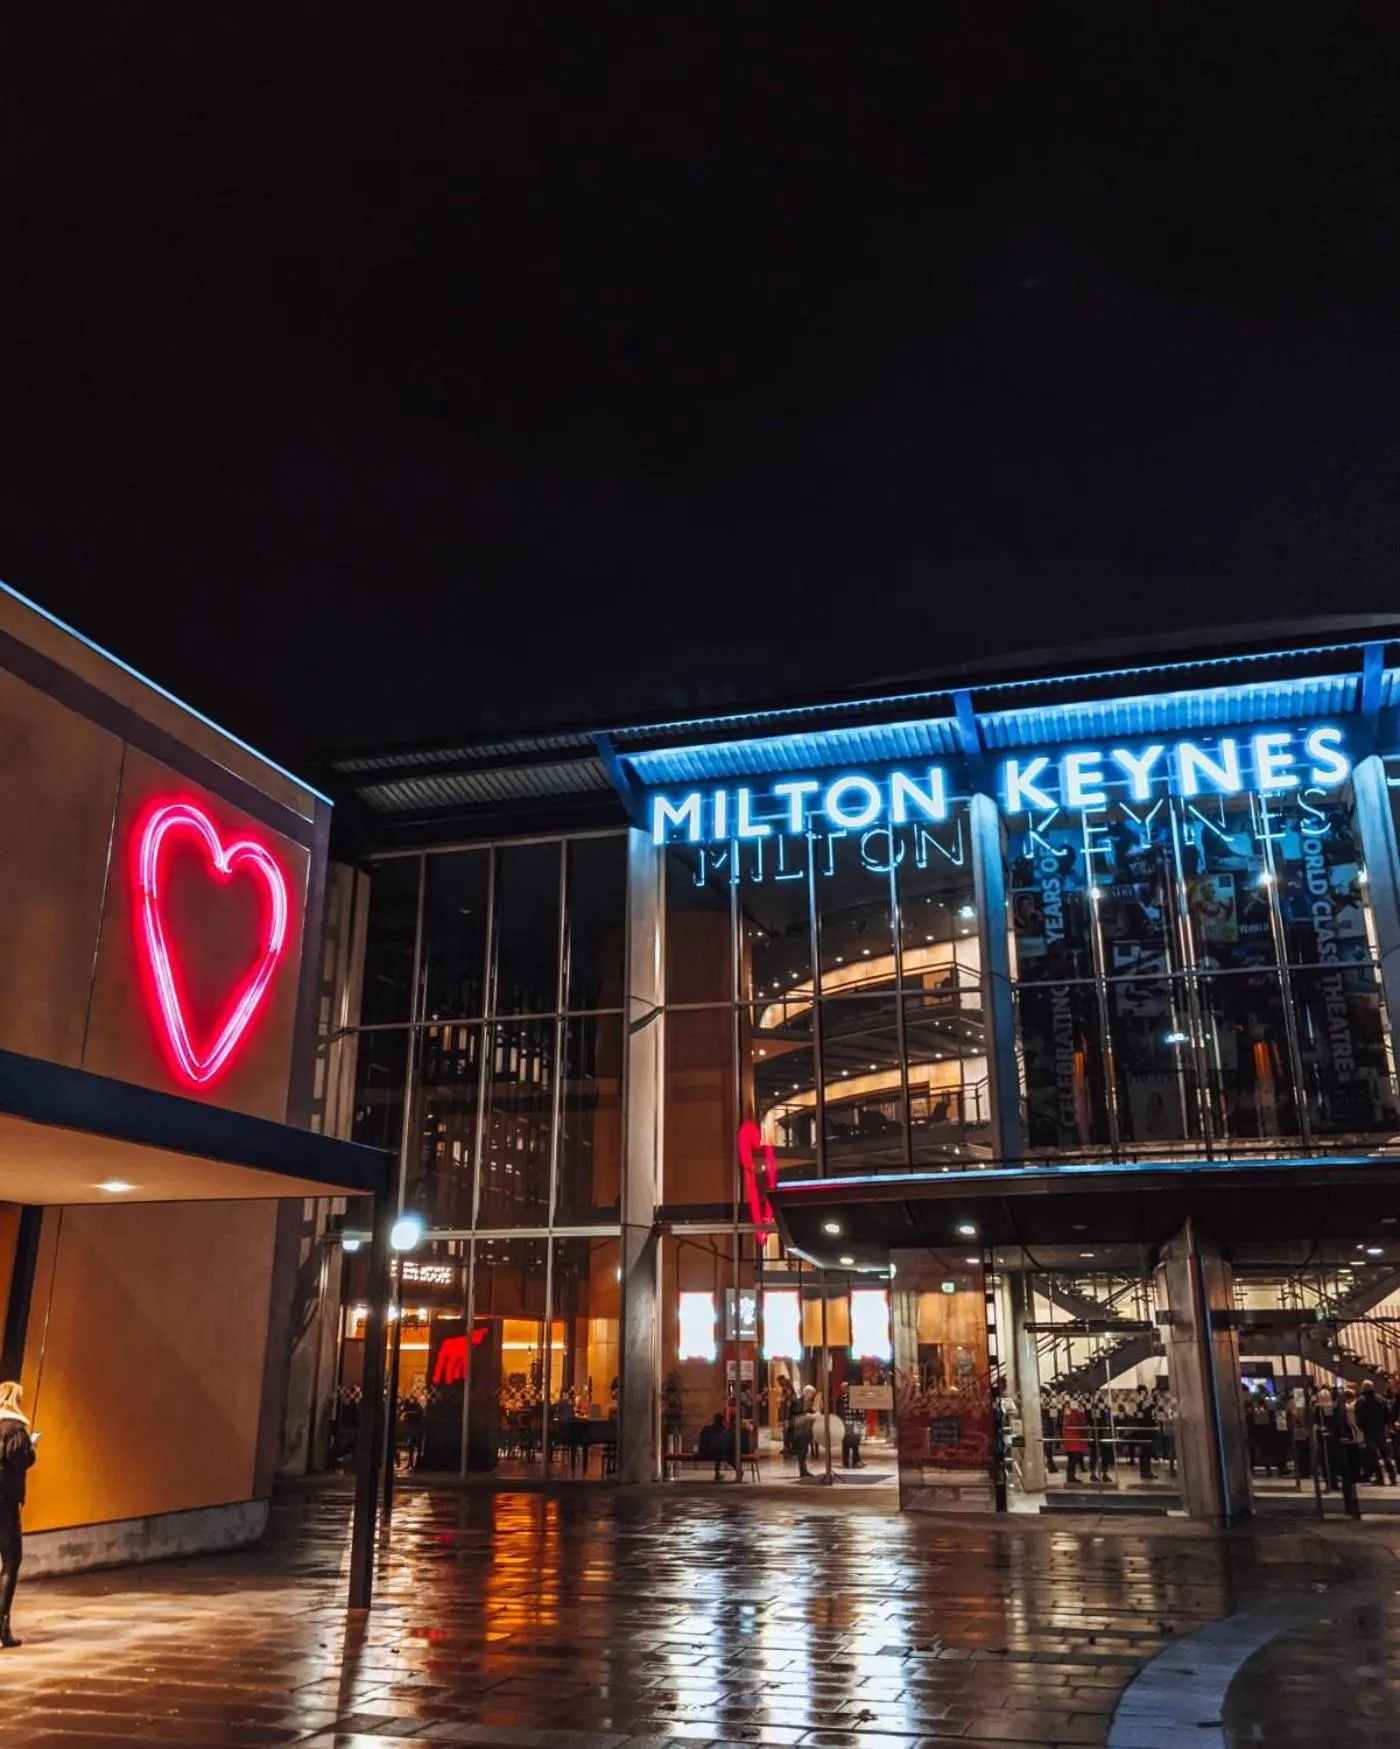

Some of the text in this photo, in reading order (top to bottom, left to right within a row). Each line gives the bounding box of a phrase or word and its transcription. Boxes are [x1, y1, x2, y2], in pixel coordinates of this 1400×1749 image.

[653, 727, 1350, 844] MILTON KEYNES
[1041, 878, 1065, 946] YEARS
[1311, 901, 1339, 965] CLASS
[1321, 972, 1355, 1072] THEATRE
